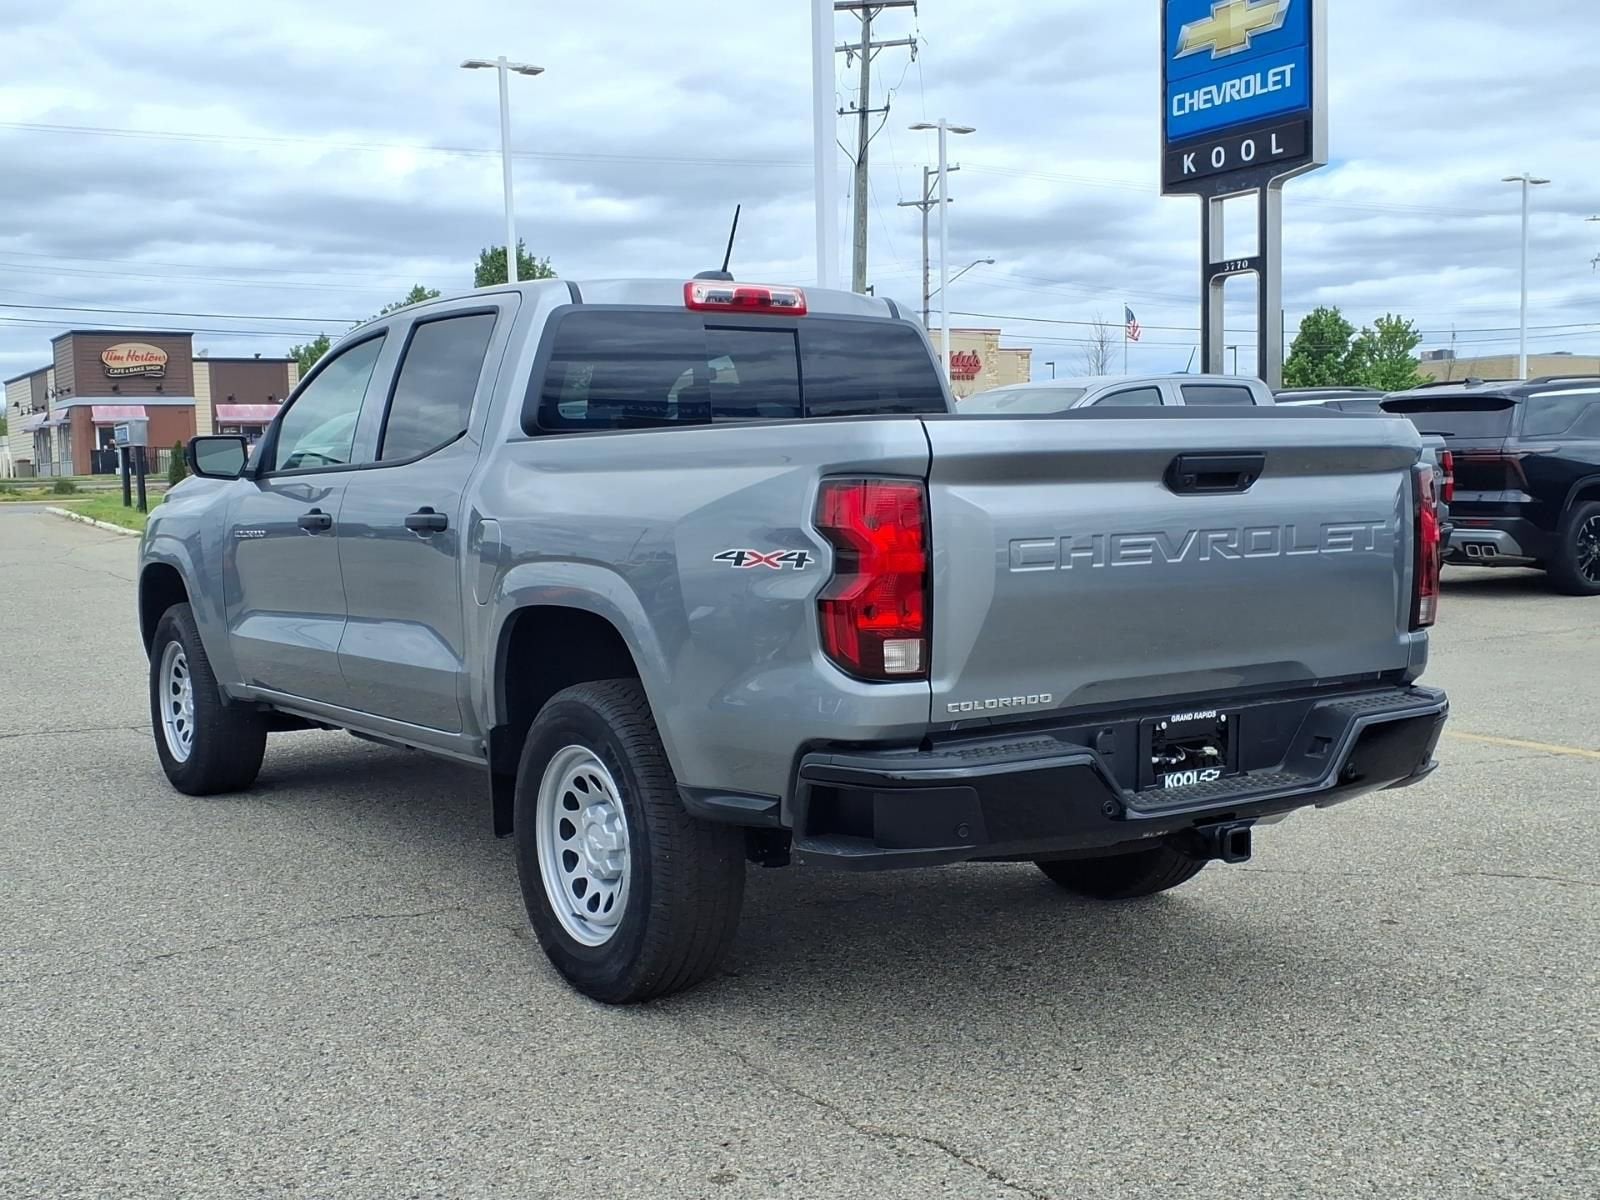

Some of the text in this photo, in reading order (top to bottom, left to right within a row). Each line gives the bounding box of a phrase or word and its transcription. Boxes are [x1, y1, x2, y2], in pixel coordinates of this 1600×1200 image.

[1172, 63, 1295, 117] CHEVROLET
[1183, 133, 1284, 174] KOOL
[1224, 259, 1249, 272] 3770
[104, 349, 124, 362] Tim
[1008, 520, 1387, 572] CHEVROLET
[947, 693, 1052, 713] COLORADO
[1171, 710, 1217, 723] GRAND RAPIDS
[1164, 771, 1200, 789] KOOL
